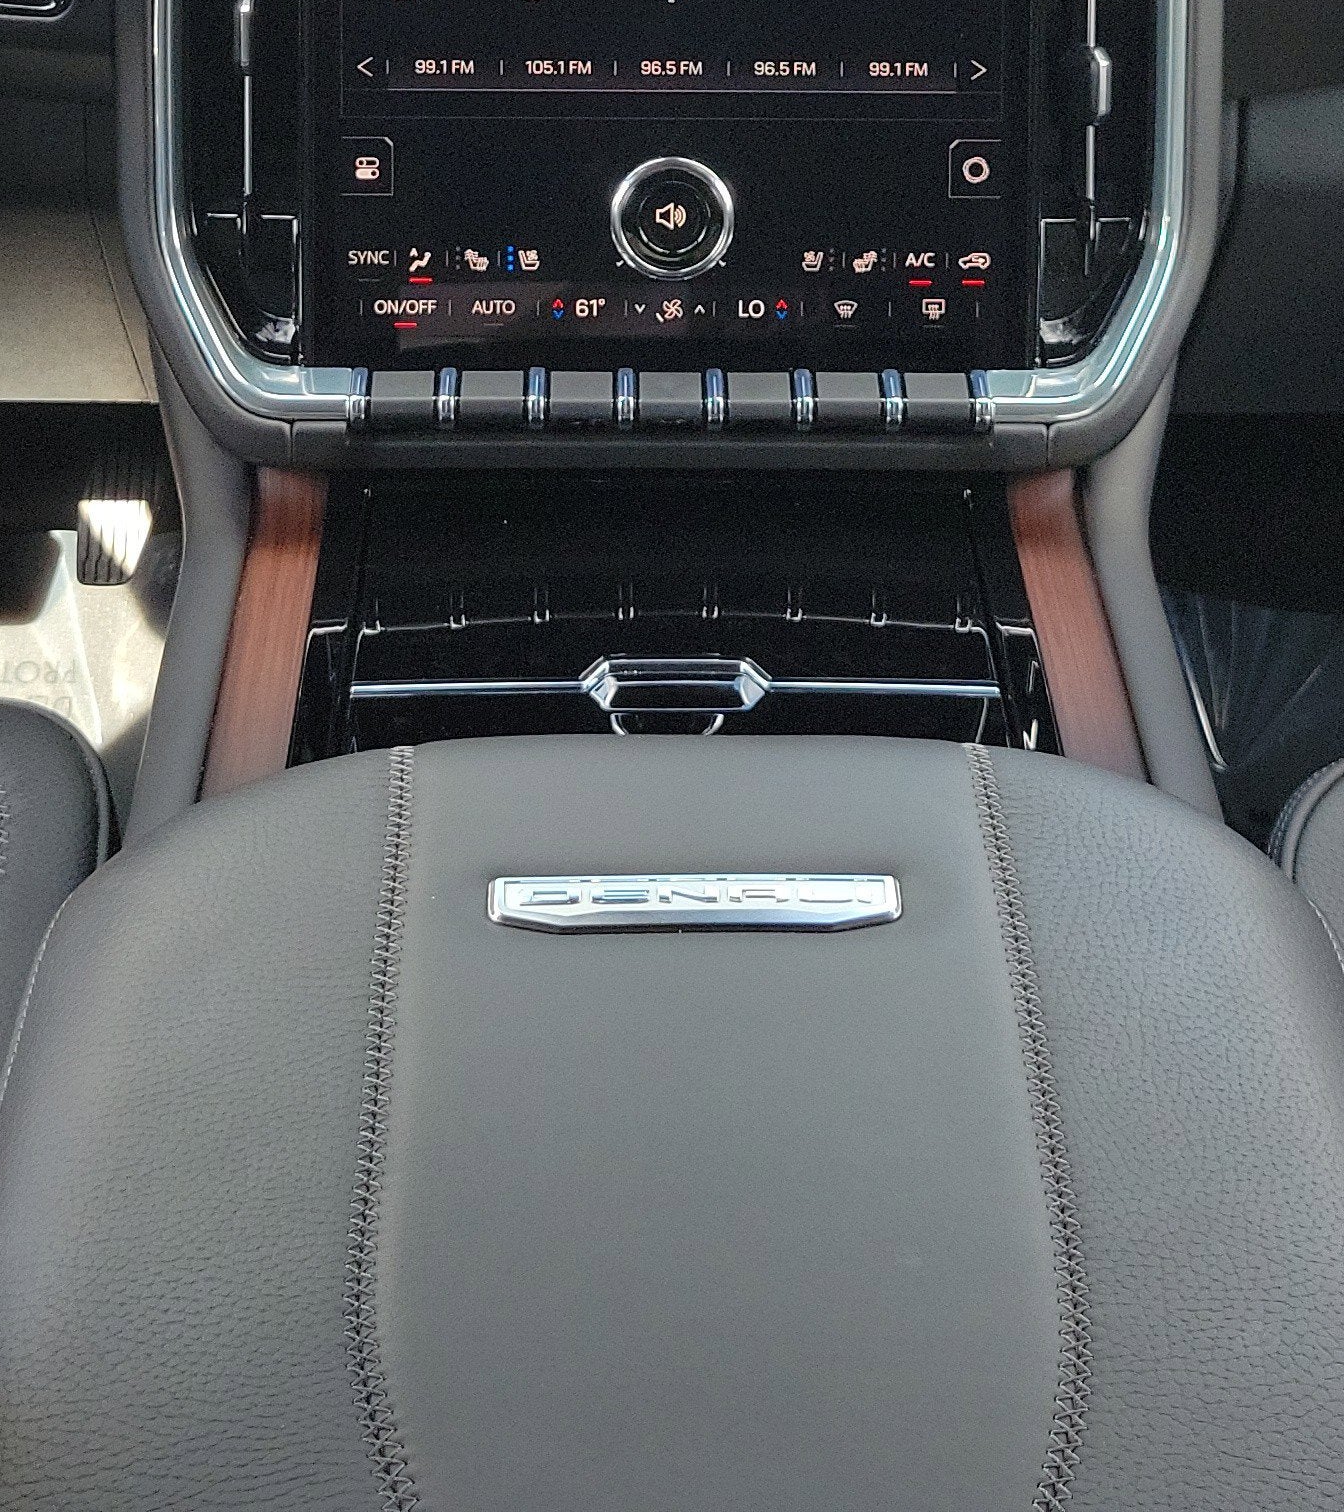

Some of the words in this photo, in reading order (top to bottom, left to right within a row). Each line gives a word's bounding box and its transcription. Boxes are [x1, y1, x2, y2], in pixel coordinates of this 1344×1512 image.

[414, 59, 447, 75] 99.1
[452, 60, 475, 75] FM
[525, 60, 565, 75] 105.1
[569, 61, 592, 75] FM
[640, 61, 676, 75] 96.5
[680, 61, 703, 76] FM
[754, 61, 790, 76] 96.5
[793, 62, 816, 76] FM
[869, 62, 901, 77] 99.1
[905, 62, 928, 77] FM
[348, 250, 390, 265] SYNC
[905, 252, 936, 268] A/C
[373, 299, 437, 315] ON/OFF
[471, 300, 516, 315] AUTO
[575, 298, 606, 317] 61°
[737, 299, 765, 318] LO
[519, 884, 875, 906] DENALI
